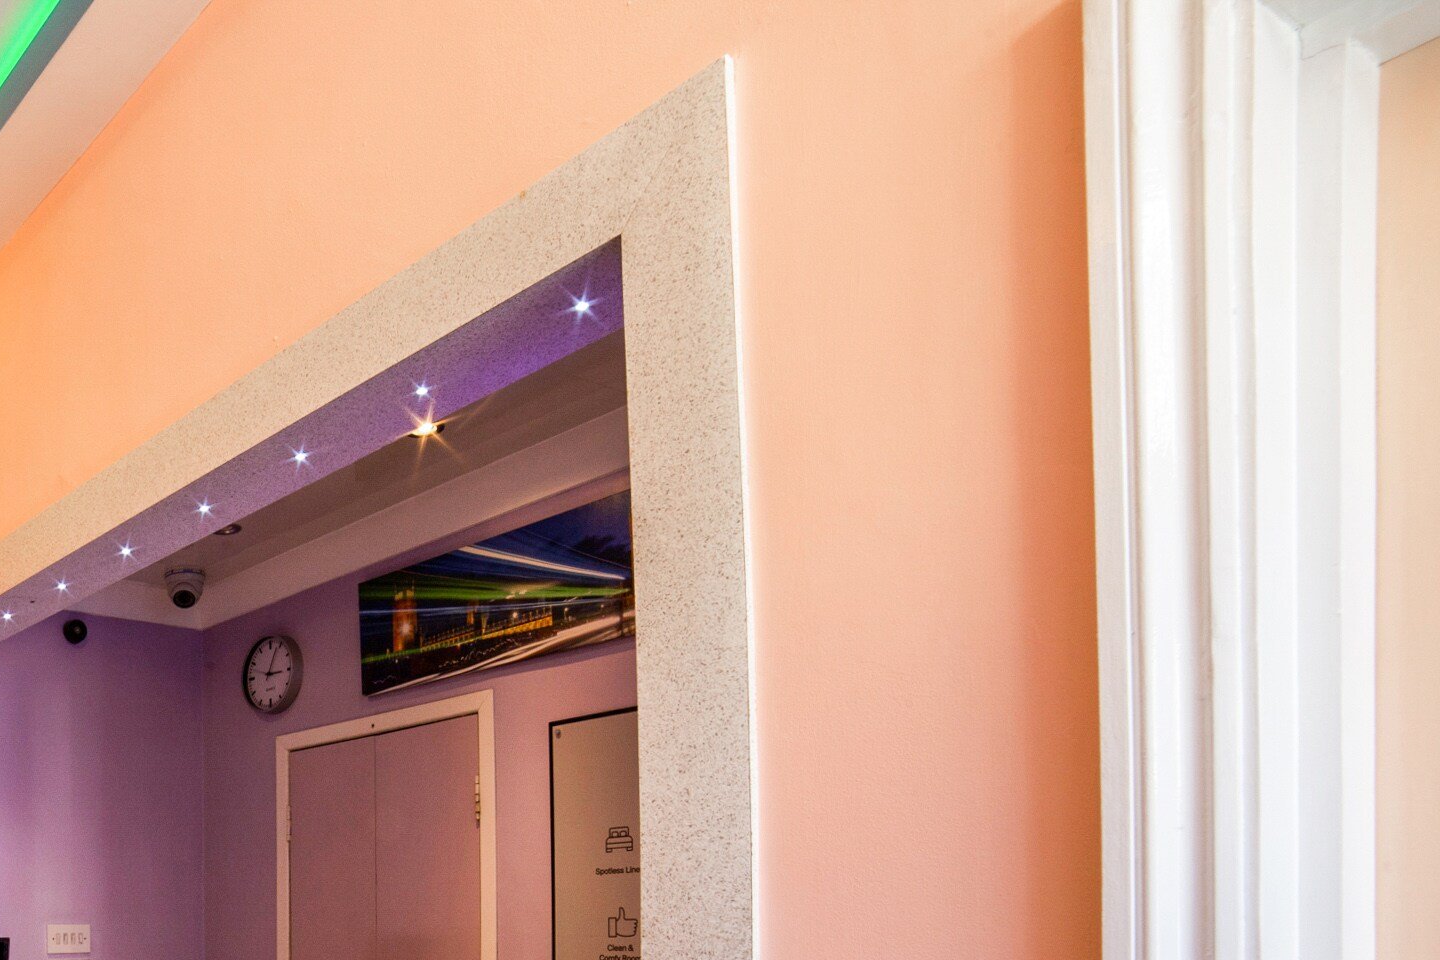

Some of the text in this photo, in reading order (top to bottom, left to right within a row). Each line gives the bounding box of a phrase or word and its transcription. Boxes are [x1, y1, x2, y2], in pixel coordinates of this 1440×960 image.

[595, 866, 624, 876] Spotless
[607, 944, 634, 952] Clean &
